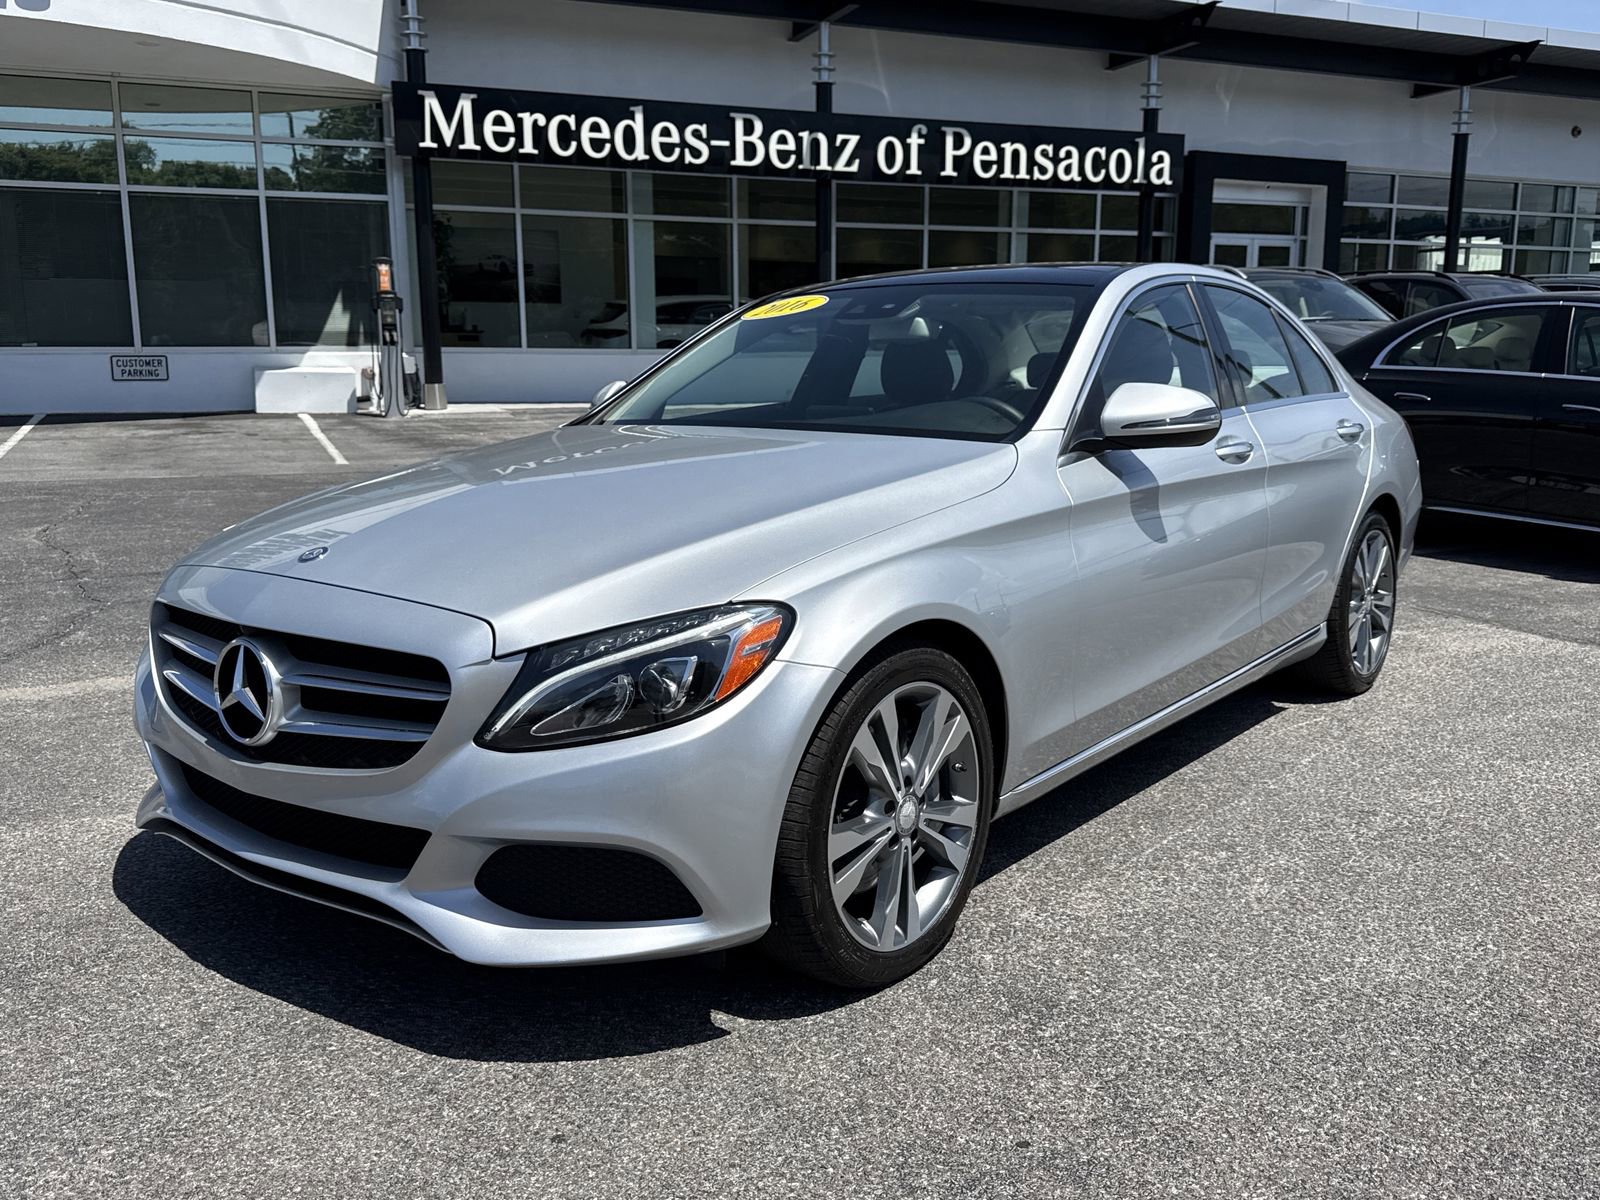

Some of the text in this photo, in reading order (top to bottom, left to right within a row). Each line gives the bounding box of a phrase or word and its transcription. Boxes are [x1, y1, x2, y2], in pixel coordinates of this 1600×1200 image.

[417, 89, 1174, 186] Mercedes-Benz of Pensacola
[115, 358, 164, 368] CUSTOMER
[120, 368, 160, 378] PARKING
